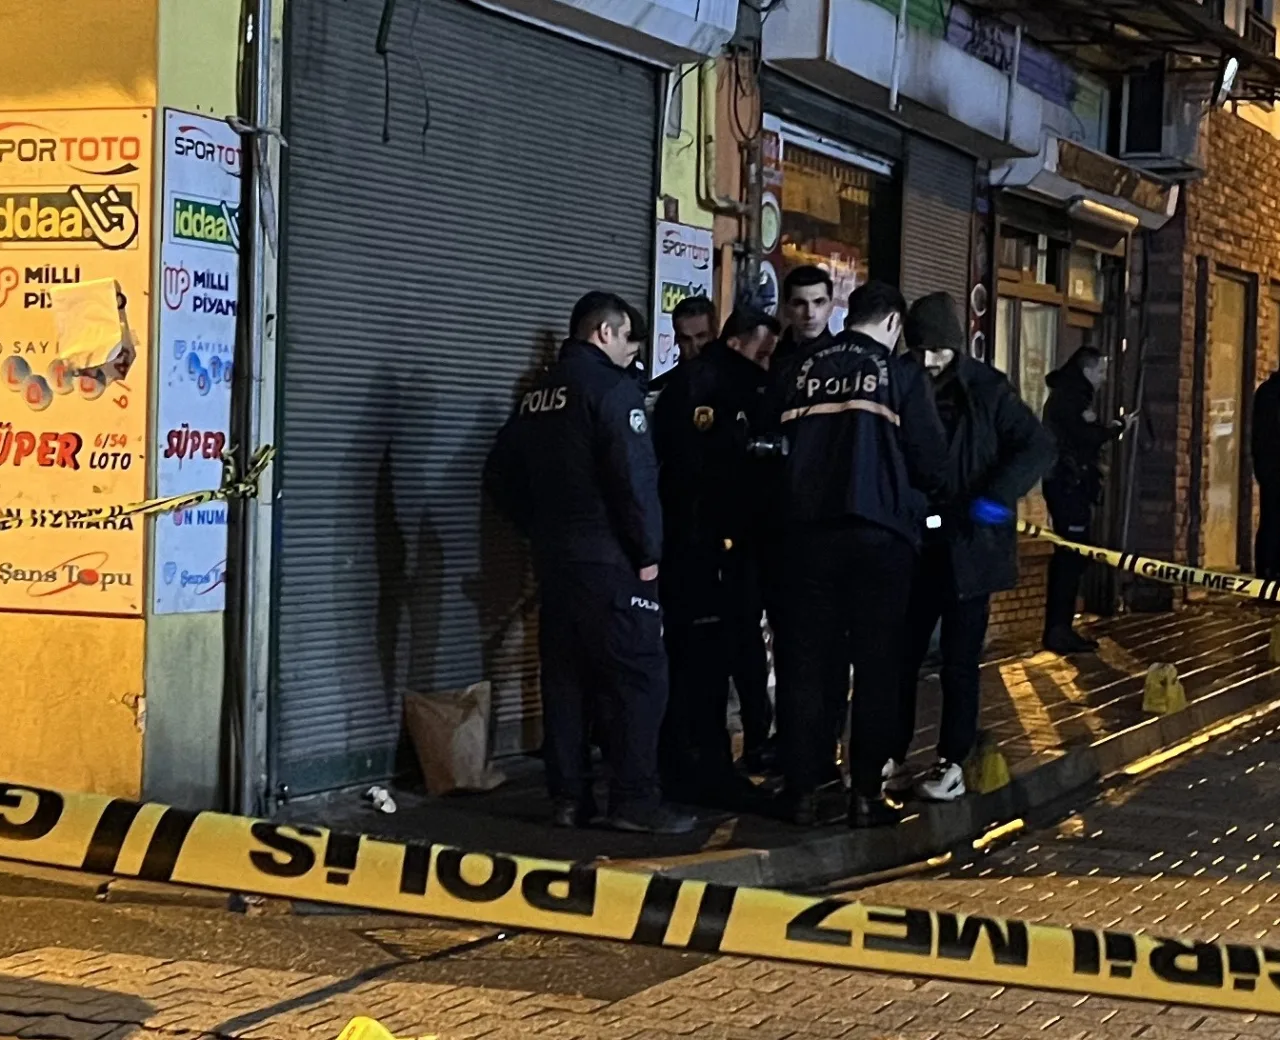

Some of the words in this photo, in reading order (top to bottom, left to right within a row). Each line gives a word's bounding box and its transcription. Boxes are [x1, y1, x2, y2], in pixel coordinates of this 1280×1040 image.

[192, 293, 237, 317] PİYAN
[164, 423, 225, 460] SÜPER
[89, 452, 131, 470] LOTO
[197, 509, 228, 526] NUM
